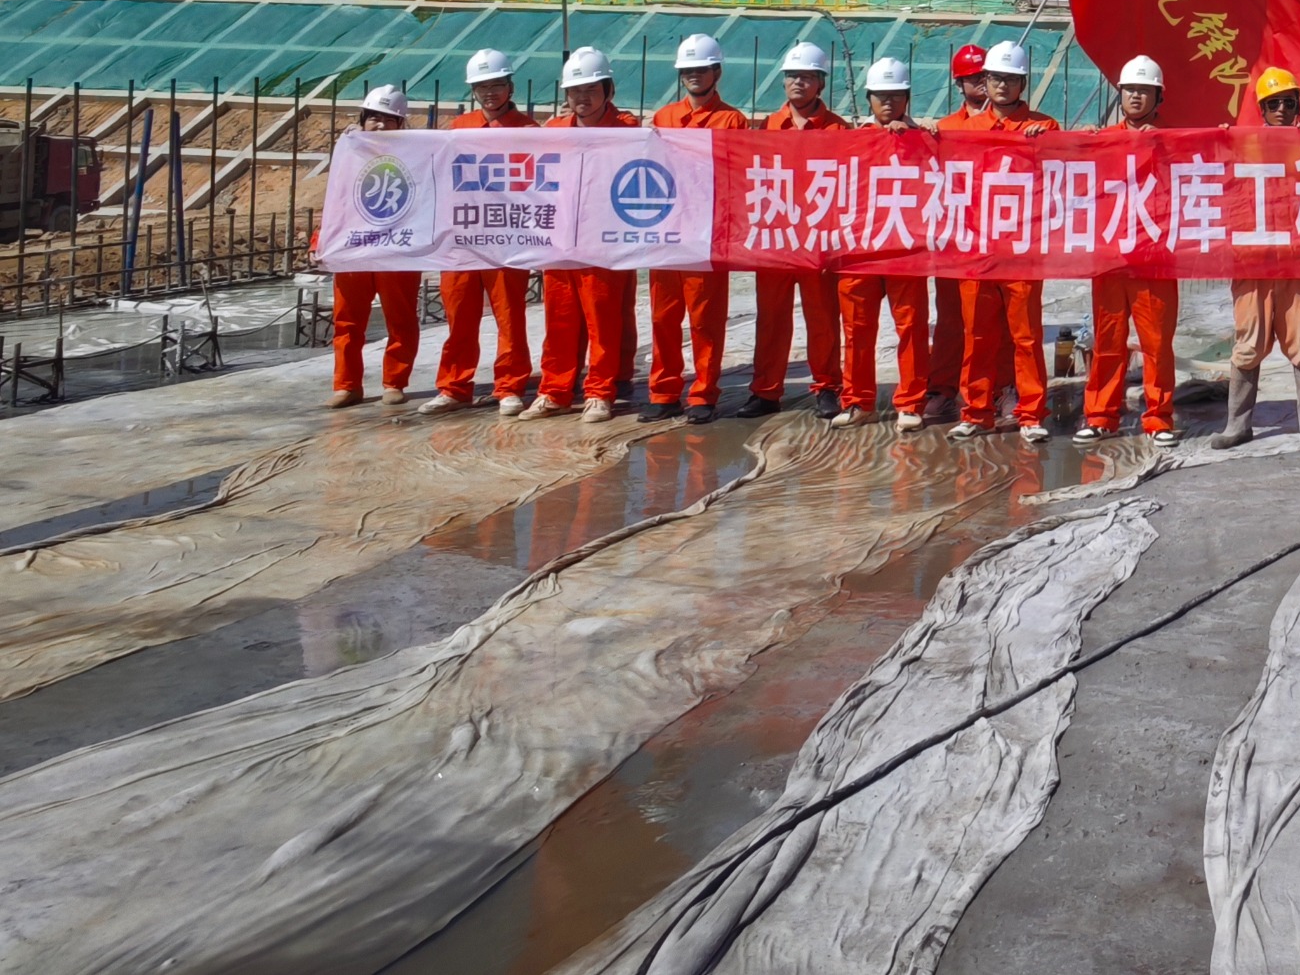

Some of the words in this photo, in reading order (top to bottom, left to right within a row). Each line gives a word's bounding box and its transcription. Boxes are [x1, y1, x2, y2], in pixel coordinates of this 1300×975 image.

[453, 203, 557, 229] 中国能建
[344, 228, 413, 247] 海南水发
[454, 233, 514, 246] ENERGY
[517, 234, 553, 247] CHINA
[601, 231, 682, 244] CGGC
